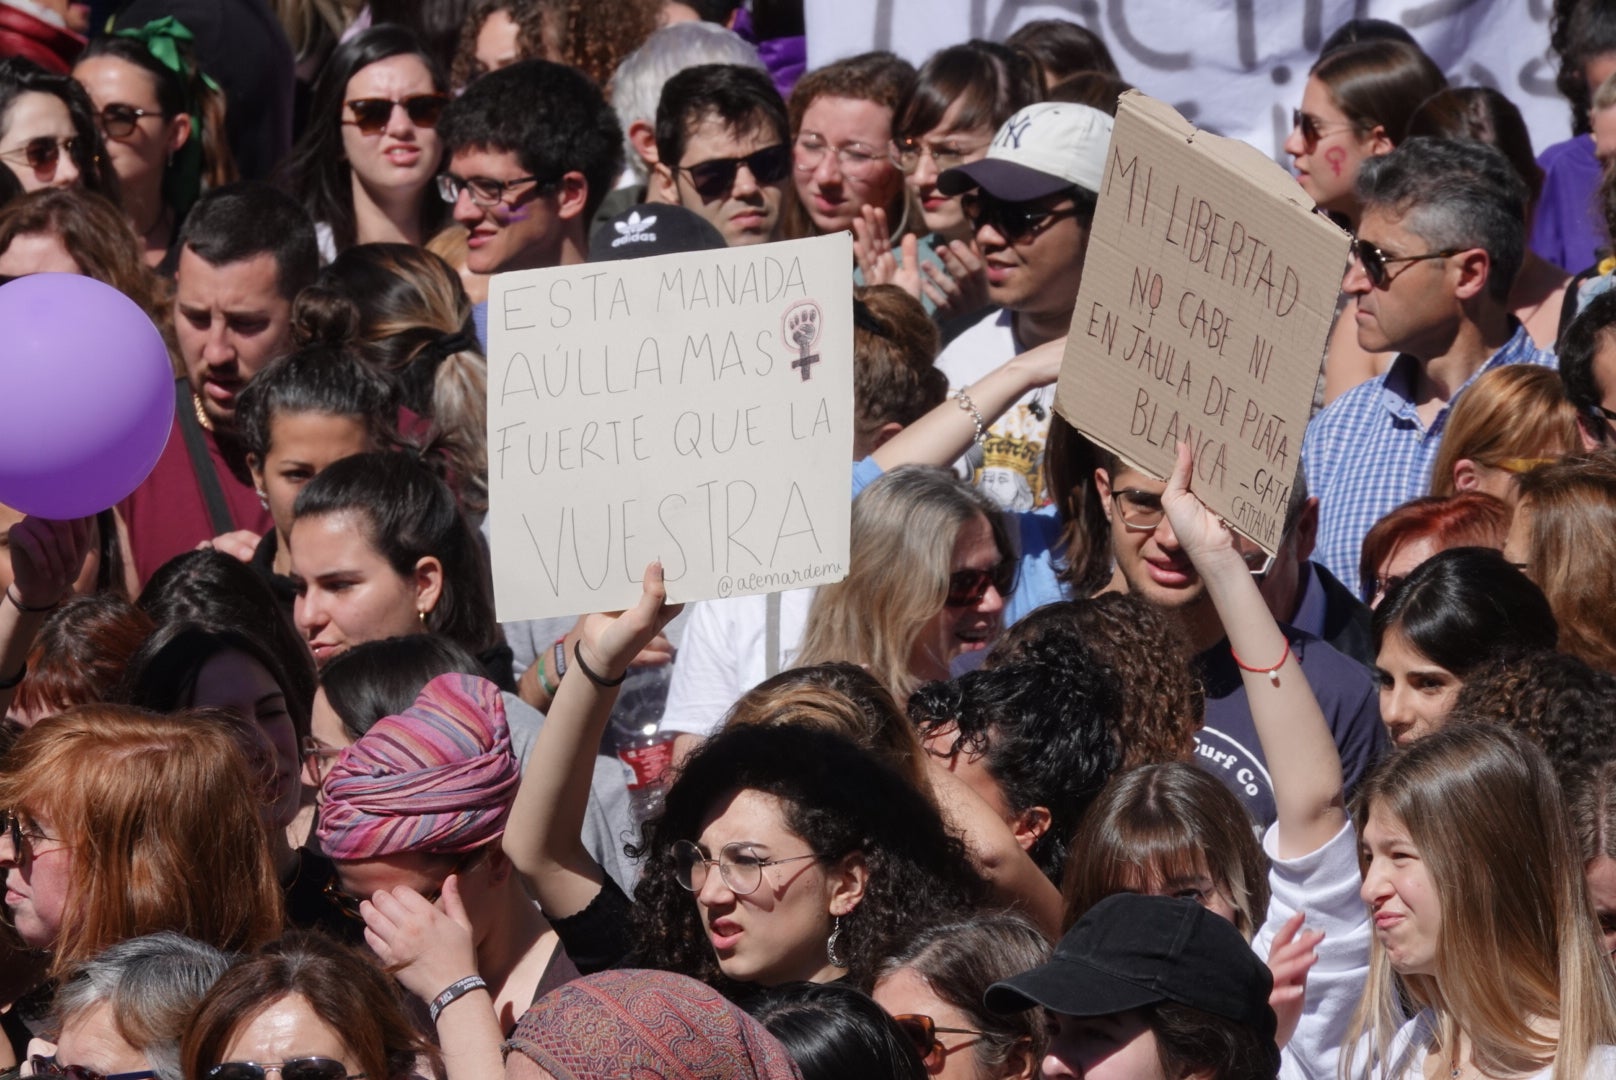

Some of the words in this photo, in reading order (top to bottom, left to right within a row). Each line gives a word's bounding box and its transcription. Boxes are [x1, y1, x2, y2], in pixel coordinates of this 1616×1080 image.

[611, 231, 657, 248] adidas
[1107, 145, 1152, 228] MI
[1166, 185, 1299, 317] LIBERTAD
[503, 271, 631, 331] ESTA
[656, 256, 807, 313] MANADA
[1129, 266, 1164, 324] NO
[1178, 292, 1234, 356] CABE
[1248, 334, 1274, 385] NI
[501, 337, 663, 406] AÚLLA
[679, 329, 774, 385] MAS
[1087, 301, 1120, 355] EN
[1123, 325, 1193, 400] JAULA
[1203, 375, 1236, 426] DE
[1239, 399, 1289, 470] PLATA
[496, 414, 650, 480] FUERTE
[673, 405, 765, 459] QUE
[790, 397, 832, 440] LA
[1130, 388, 1228, 491] BLANCA
[521, 479, 823, 598] VUESTRA
[1231, 496, 1277, 545] CATTANA
[1236, 768, 1259, 796] Co
